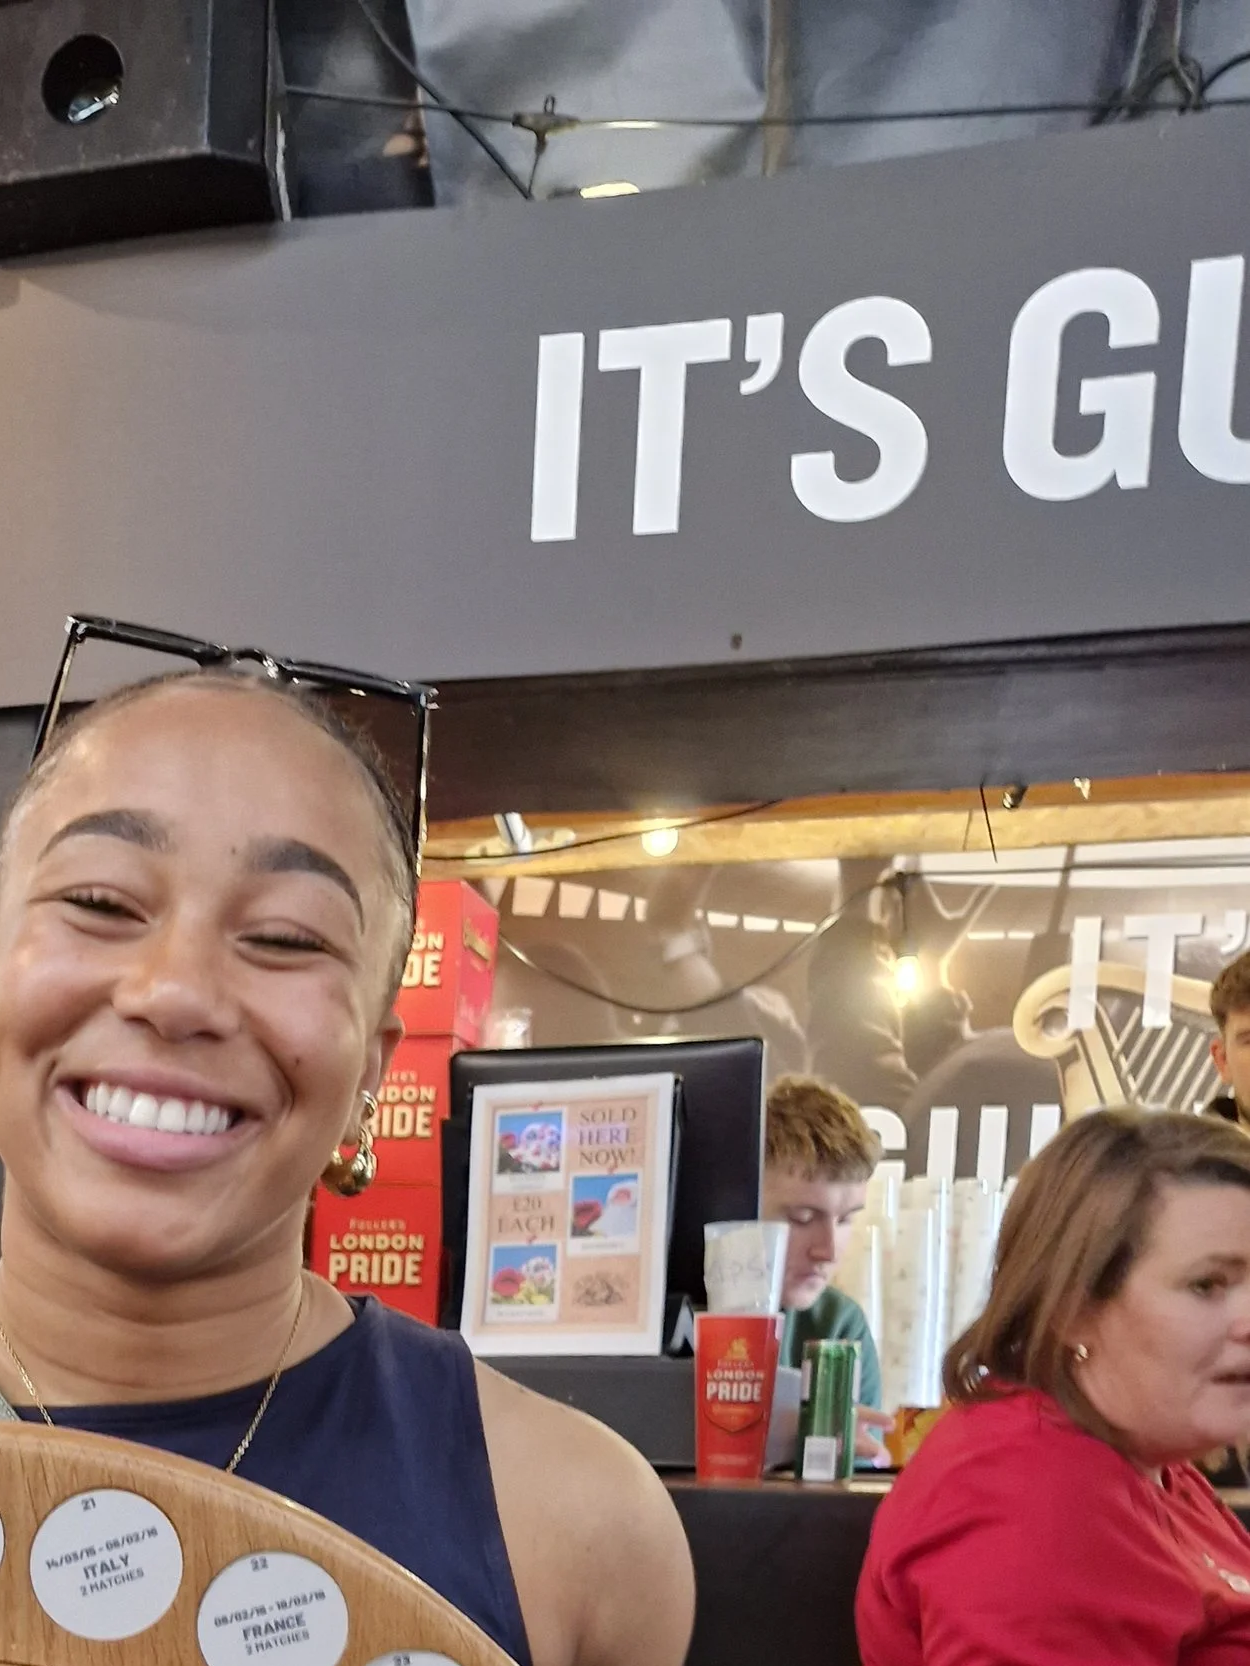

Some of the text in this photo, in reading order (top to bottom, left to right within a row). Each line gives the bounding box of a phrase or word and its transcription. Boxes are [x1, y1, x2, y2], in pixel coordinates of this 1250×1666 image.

[531, 296, 932, 542] IT'S
[580, 1107, 637, 1125] SOLD
[579, 1127, 632, 1145] HERE
[579, 1149, 635, 1166] NOW!
[498, 1215, 555, 1233] EACH
[329, 1233, 424, 1250] LONDON
[329, 1251, 423, 1286] PRIDE
[706, 1370, 764, 1380] LONDON
[706, 1382, 762, 1401] PRIDE
[82, 1498, 96, 1511] 21
[84, 1555, 130, 1580] ITALY
[90, 1569, 144, 1593] MATCHES
[243, 1613, 305, 1640] FRANCE
[255, 1630, 310, 1652] MATCHES
